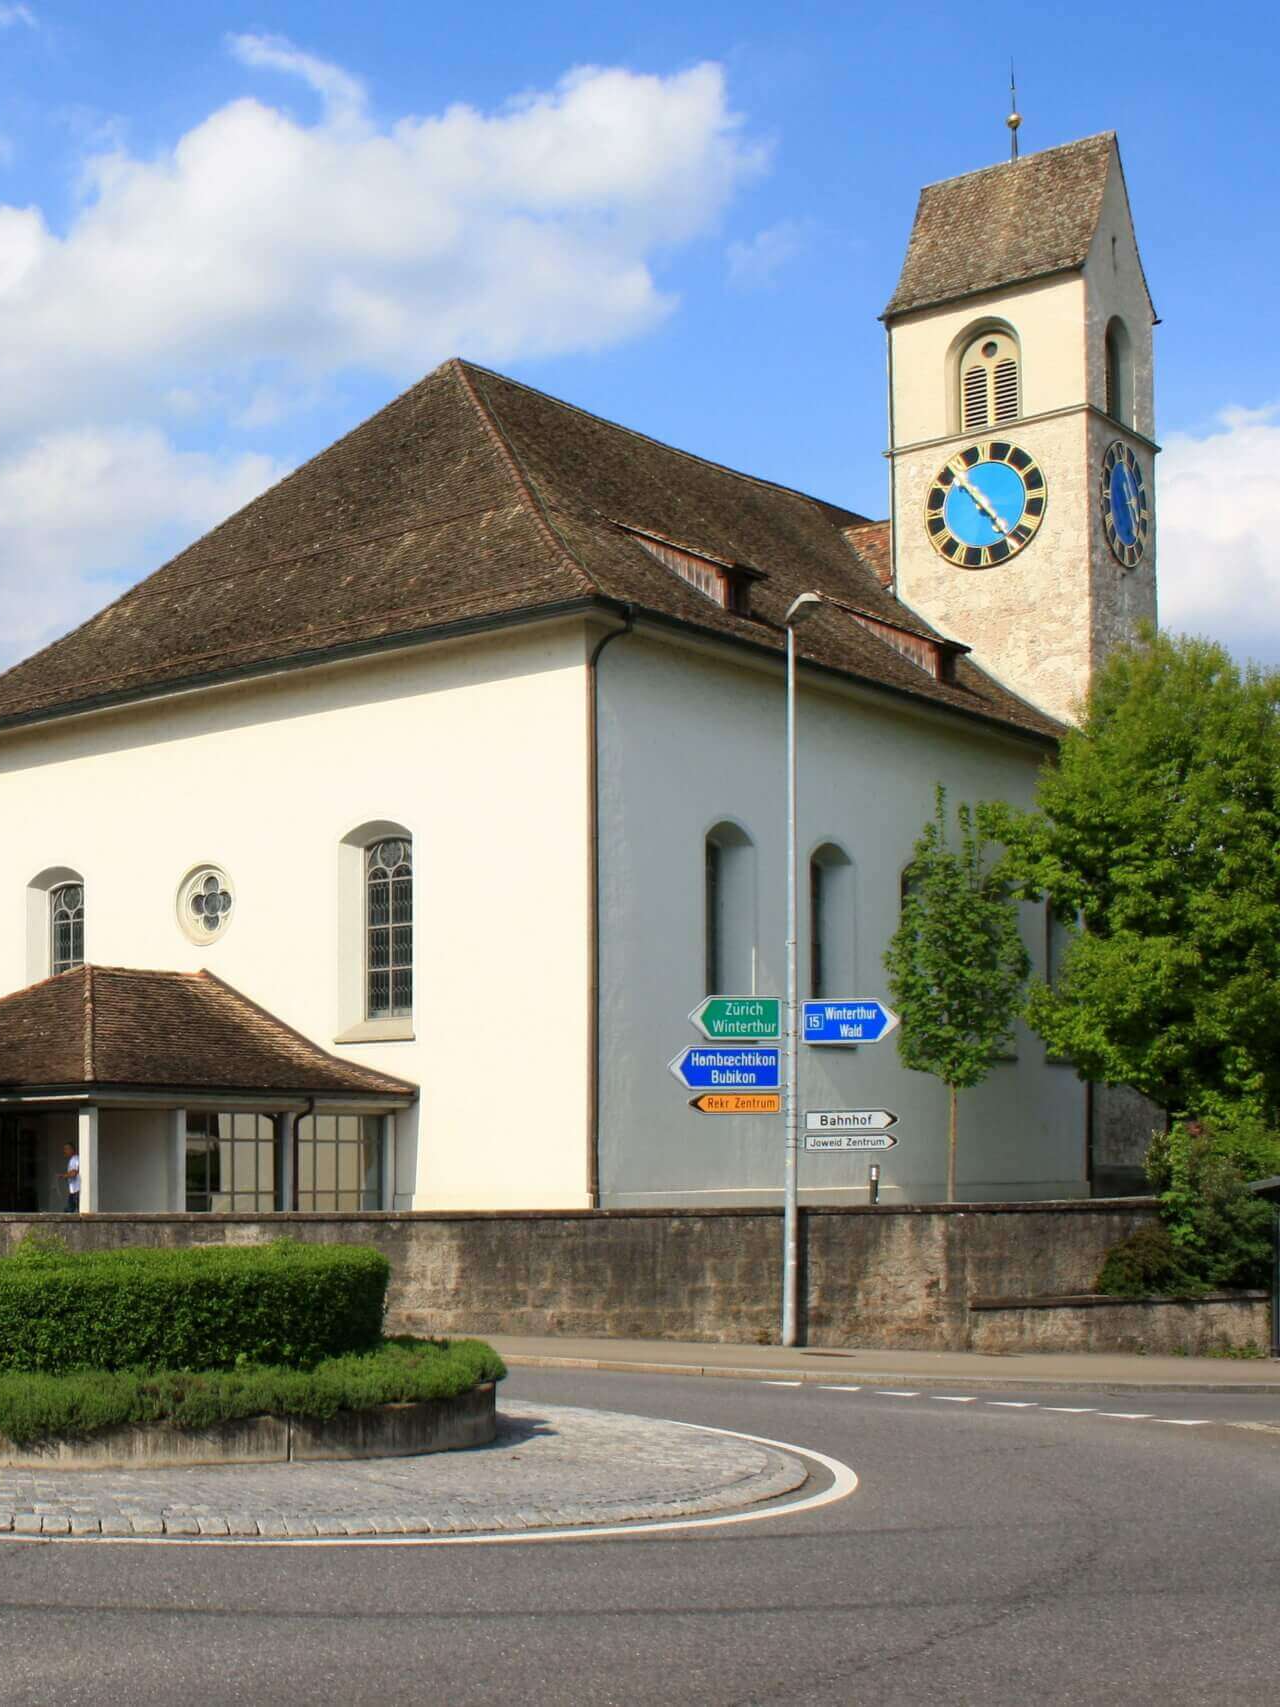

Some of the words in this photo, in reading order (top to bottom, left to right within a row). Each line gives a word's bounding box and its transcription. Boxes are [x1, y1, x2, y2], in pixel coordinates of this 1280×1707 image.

[725, 1002, 764, 1016] Zürich
[824, 1006, 878, 1020] Winterthur
[712, 1019, 776, 1033] Winterthur
[808, 1016, 820, 1028] 15
[839, 1024, 863, 1038] Wald
[691, 1052, 775, 1067] Hombrechtikon
[711, 1069, 756, 1084] Bubikon
[707, 1097, 729, 1109] Rekr
[734, 1097, 776, 1109] Zentrum
[820, 1114, 873, 1126] Bahnhof
[810, 1138, 842, 1148] Joweid
[846, 1138, 885, 1147] Zentrum
